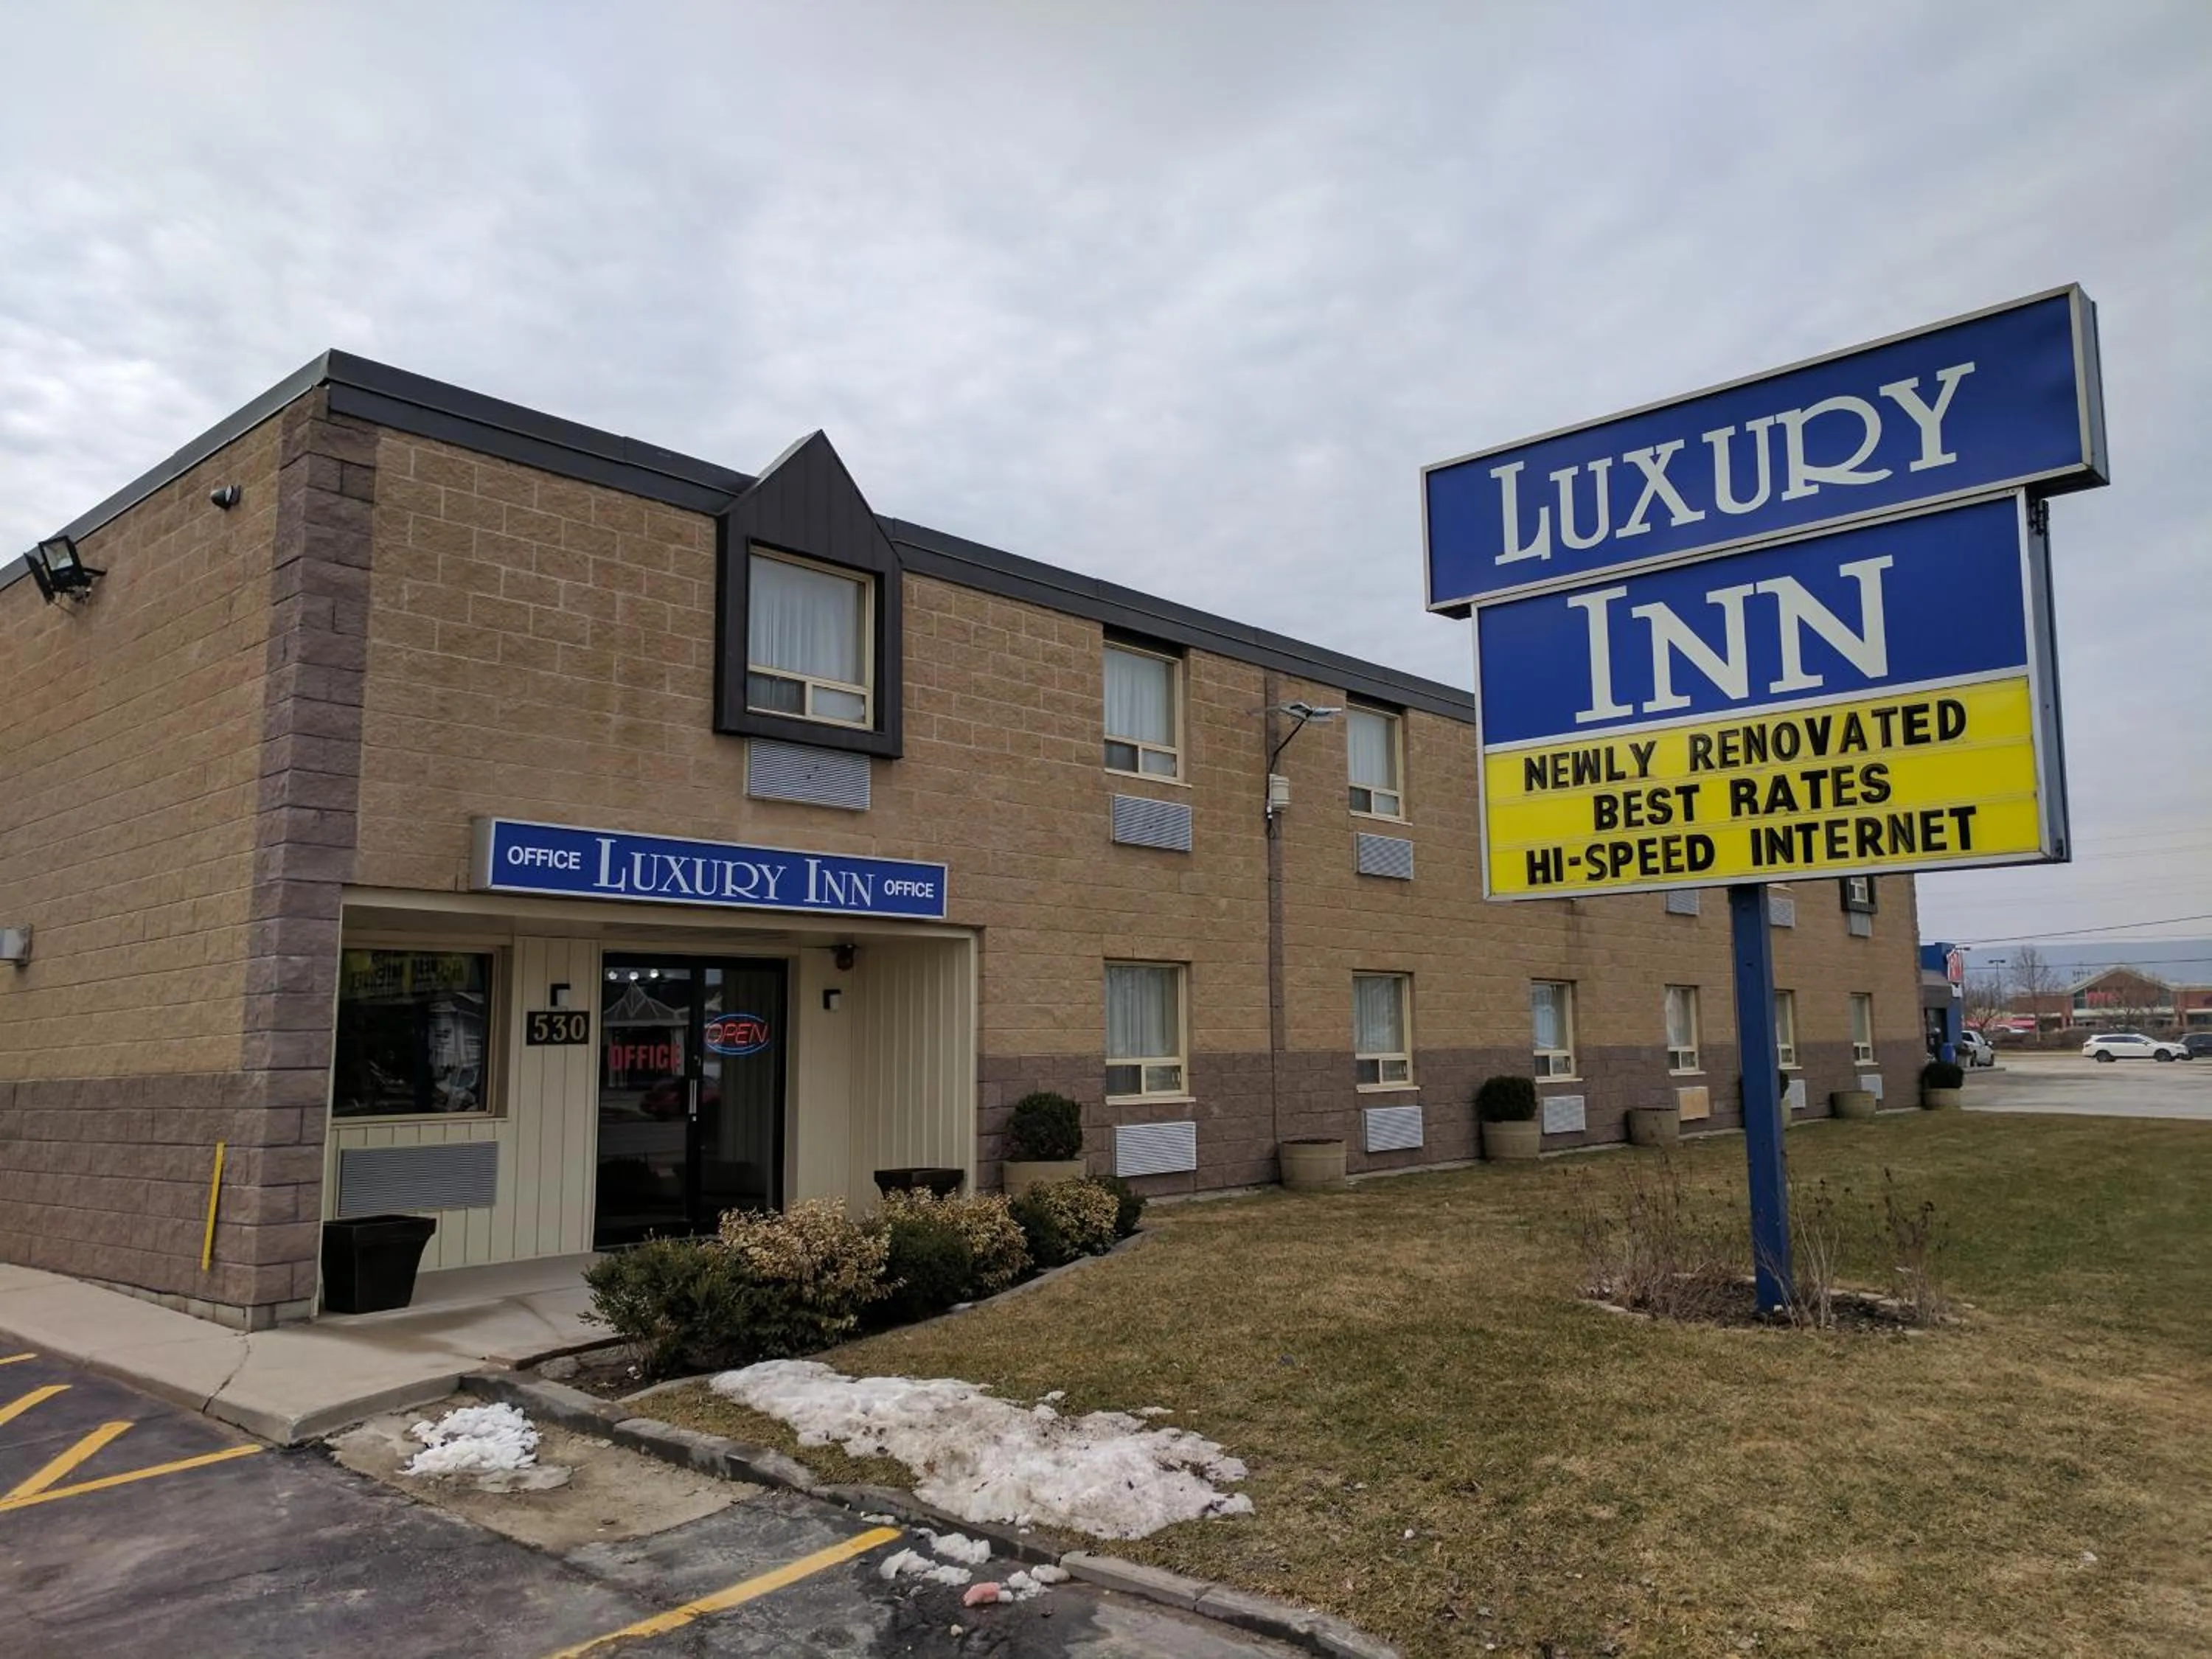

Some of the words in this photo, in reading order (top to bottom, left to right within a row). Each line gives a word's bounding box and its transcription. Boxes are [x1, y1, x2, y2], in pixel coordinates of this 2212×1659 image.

[1489, 361, 1976, 566] LUXURY
[1567, 554, 1893, 725] INN
[1523, 740, 1657, 792] NEWLY
[1688, 698, 1967, 773] RENOVATED
[1593, 784, 1700, 832] BEST
[1730, 762, 1891, 818] RATES
[507, 844, 582, 871] OFFICE
[593, 837, 787, 900] LUXURY
[803, 858, 875, 908] INN
[884, 879, 935, 898] OFFICE
[1525, 833, 1716, 886] HI-SPEED
[1750, 805, 1978, 868] INTERNET
[532, 1013, 586, 1042] 530
[611, 1042, 682, 1071] OFFICE
[706, 1022, 770, 1045] OPEN
